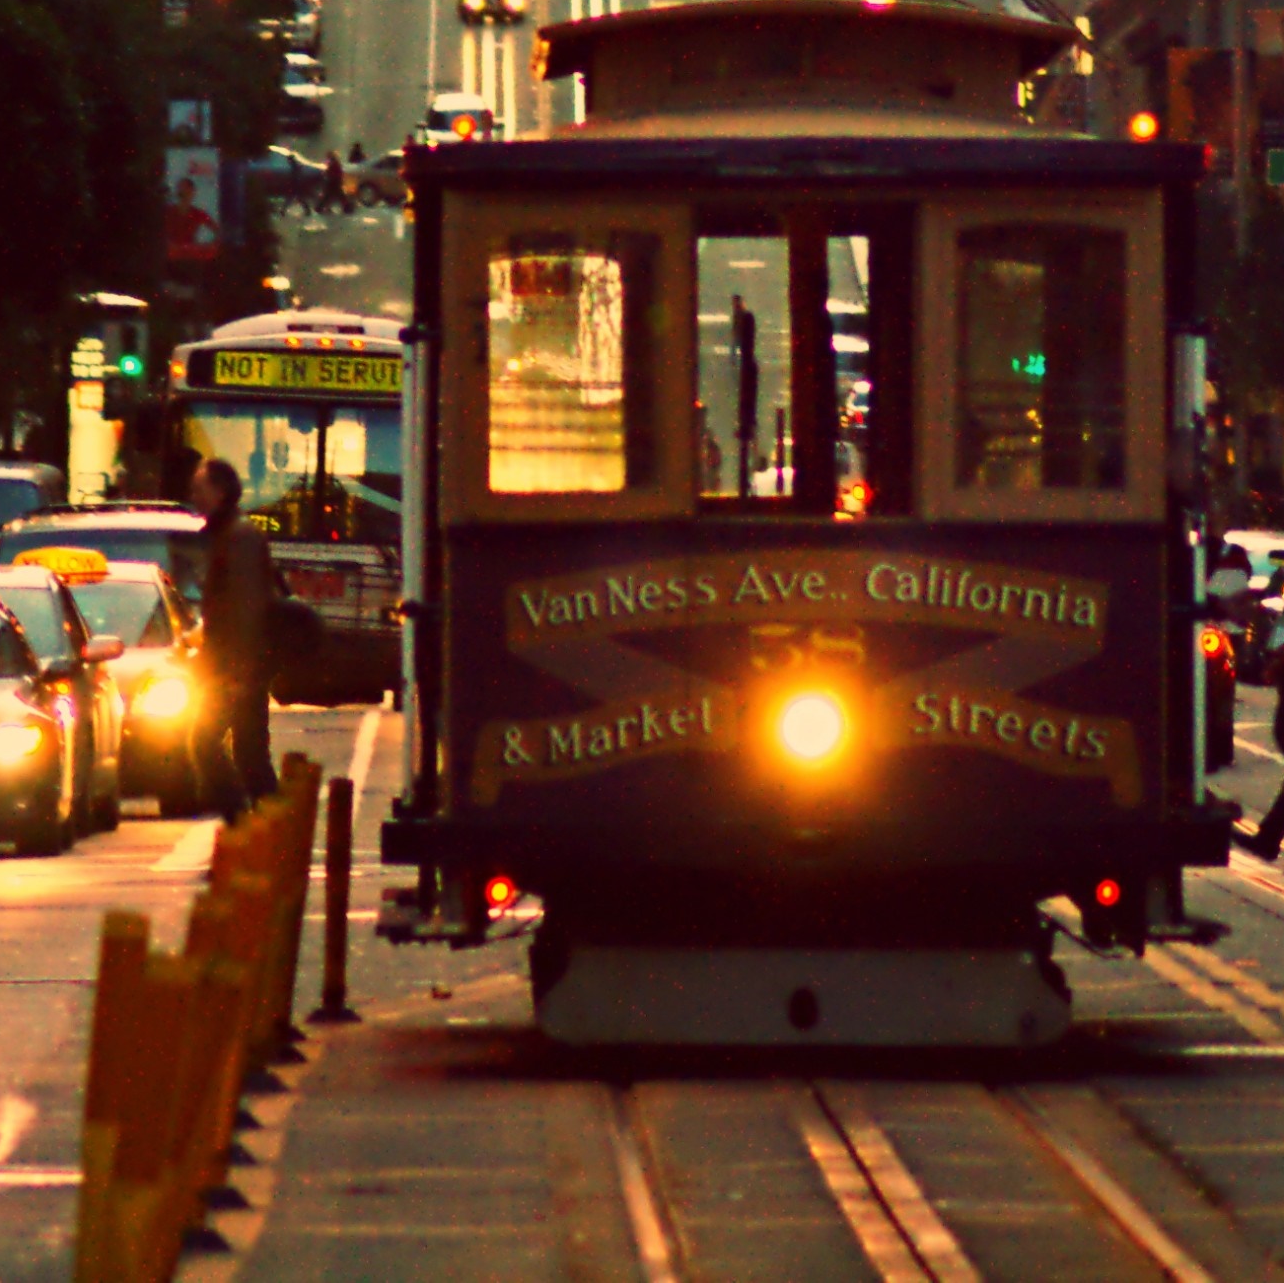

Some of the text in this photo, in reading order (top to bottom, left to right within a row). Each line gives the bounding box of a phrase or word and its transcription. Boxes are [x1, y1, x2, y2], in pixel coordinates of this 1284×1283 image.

[219, 355, 268, 380] NOT
[279, 360, 307, 382] IN
[521, 589, 598, 627] Van
[606, 574, 717, 616] Ness
[866, 562, 1097, 627] California
[503, 693, 1110, 764] & Market Streets
